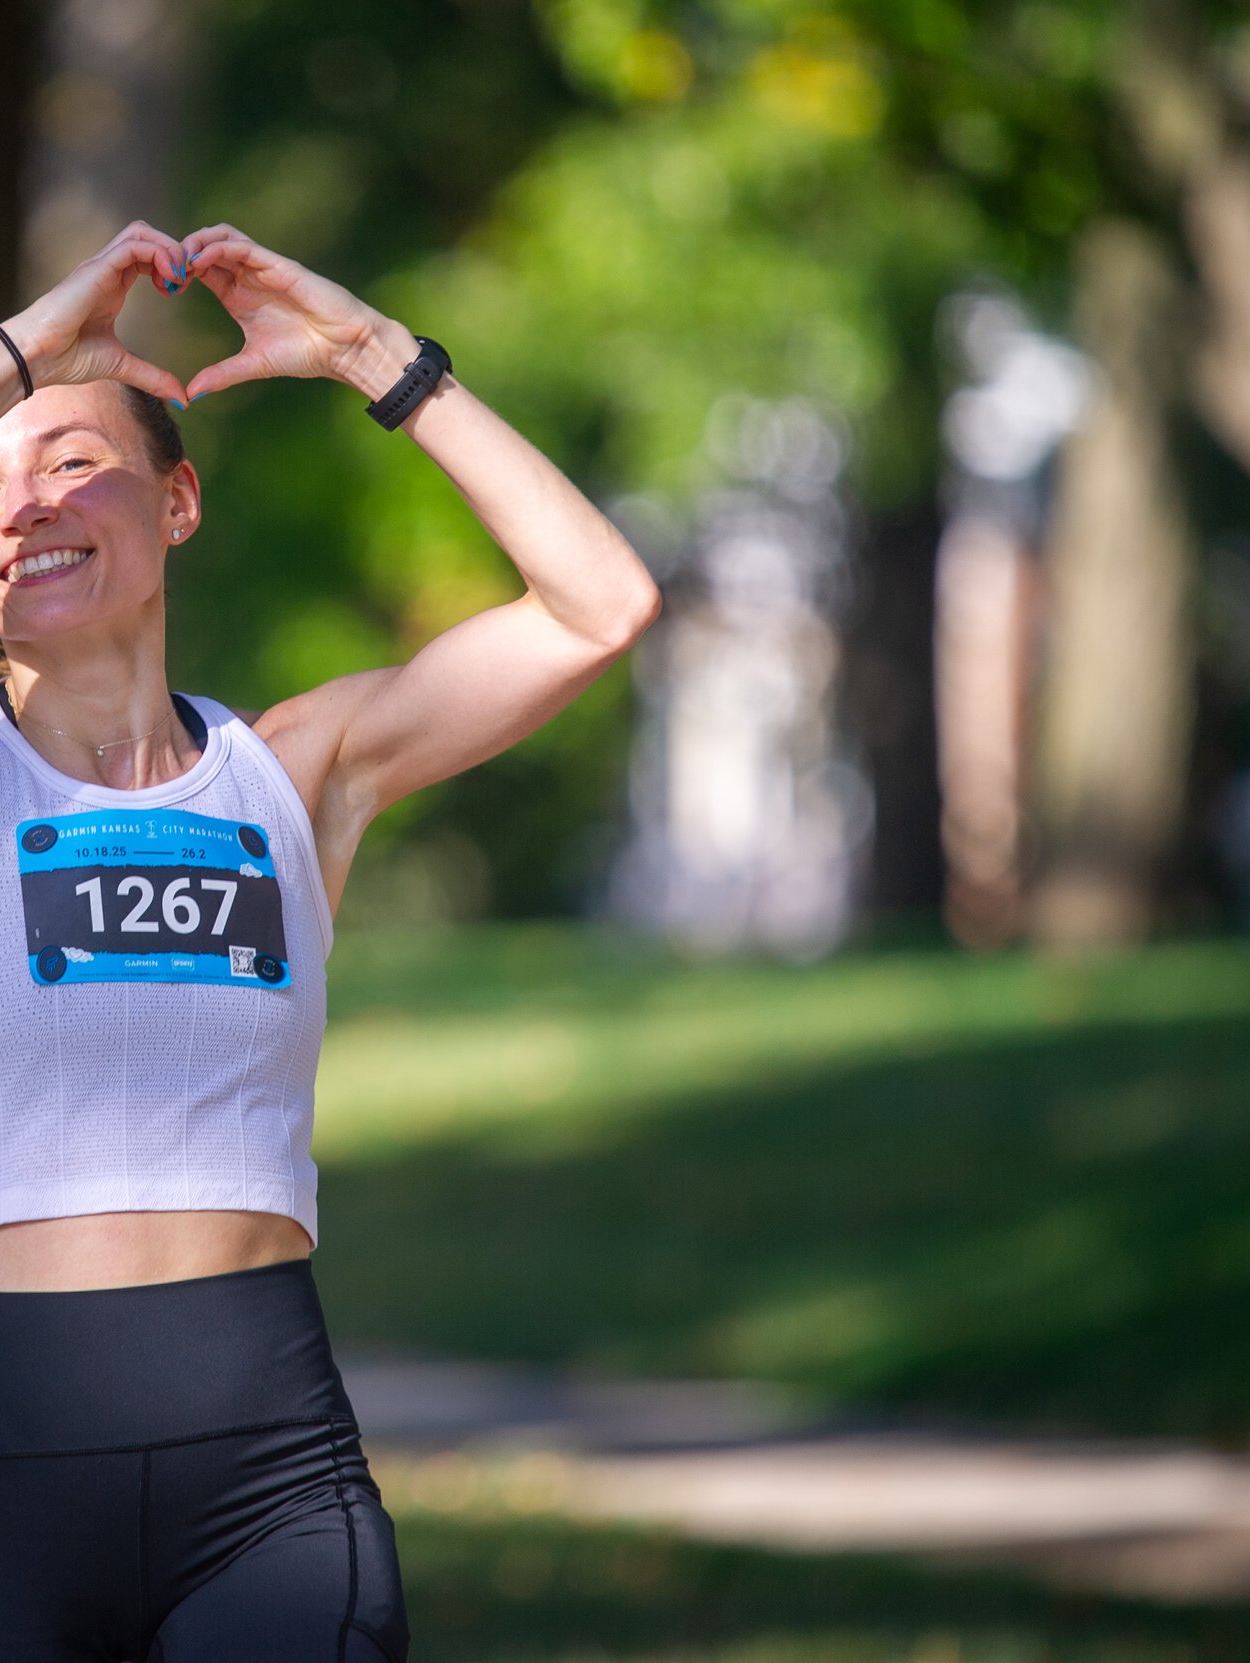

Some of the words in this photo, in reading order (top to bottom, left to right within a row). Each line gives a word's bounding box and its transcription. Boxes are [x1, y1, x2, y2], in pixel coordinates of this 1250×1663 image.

[59, 825, 97, 839] GARMIN
[101, 824, 141, 834] KANSAS
[162, 824, 184, 834] CITY
[189, 827, 233, 842] MARATHON
[75, 846, 127, 858] 10.18.25
[181, 848, 206, 859] 26.2
[75, 875, 238, 936] 1267
[124, 959, 159, 967] GARMIN
